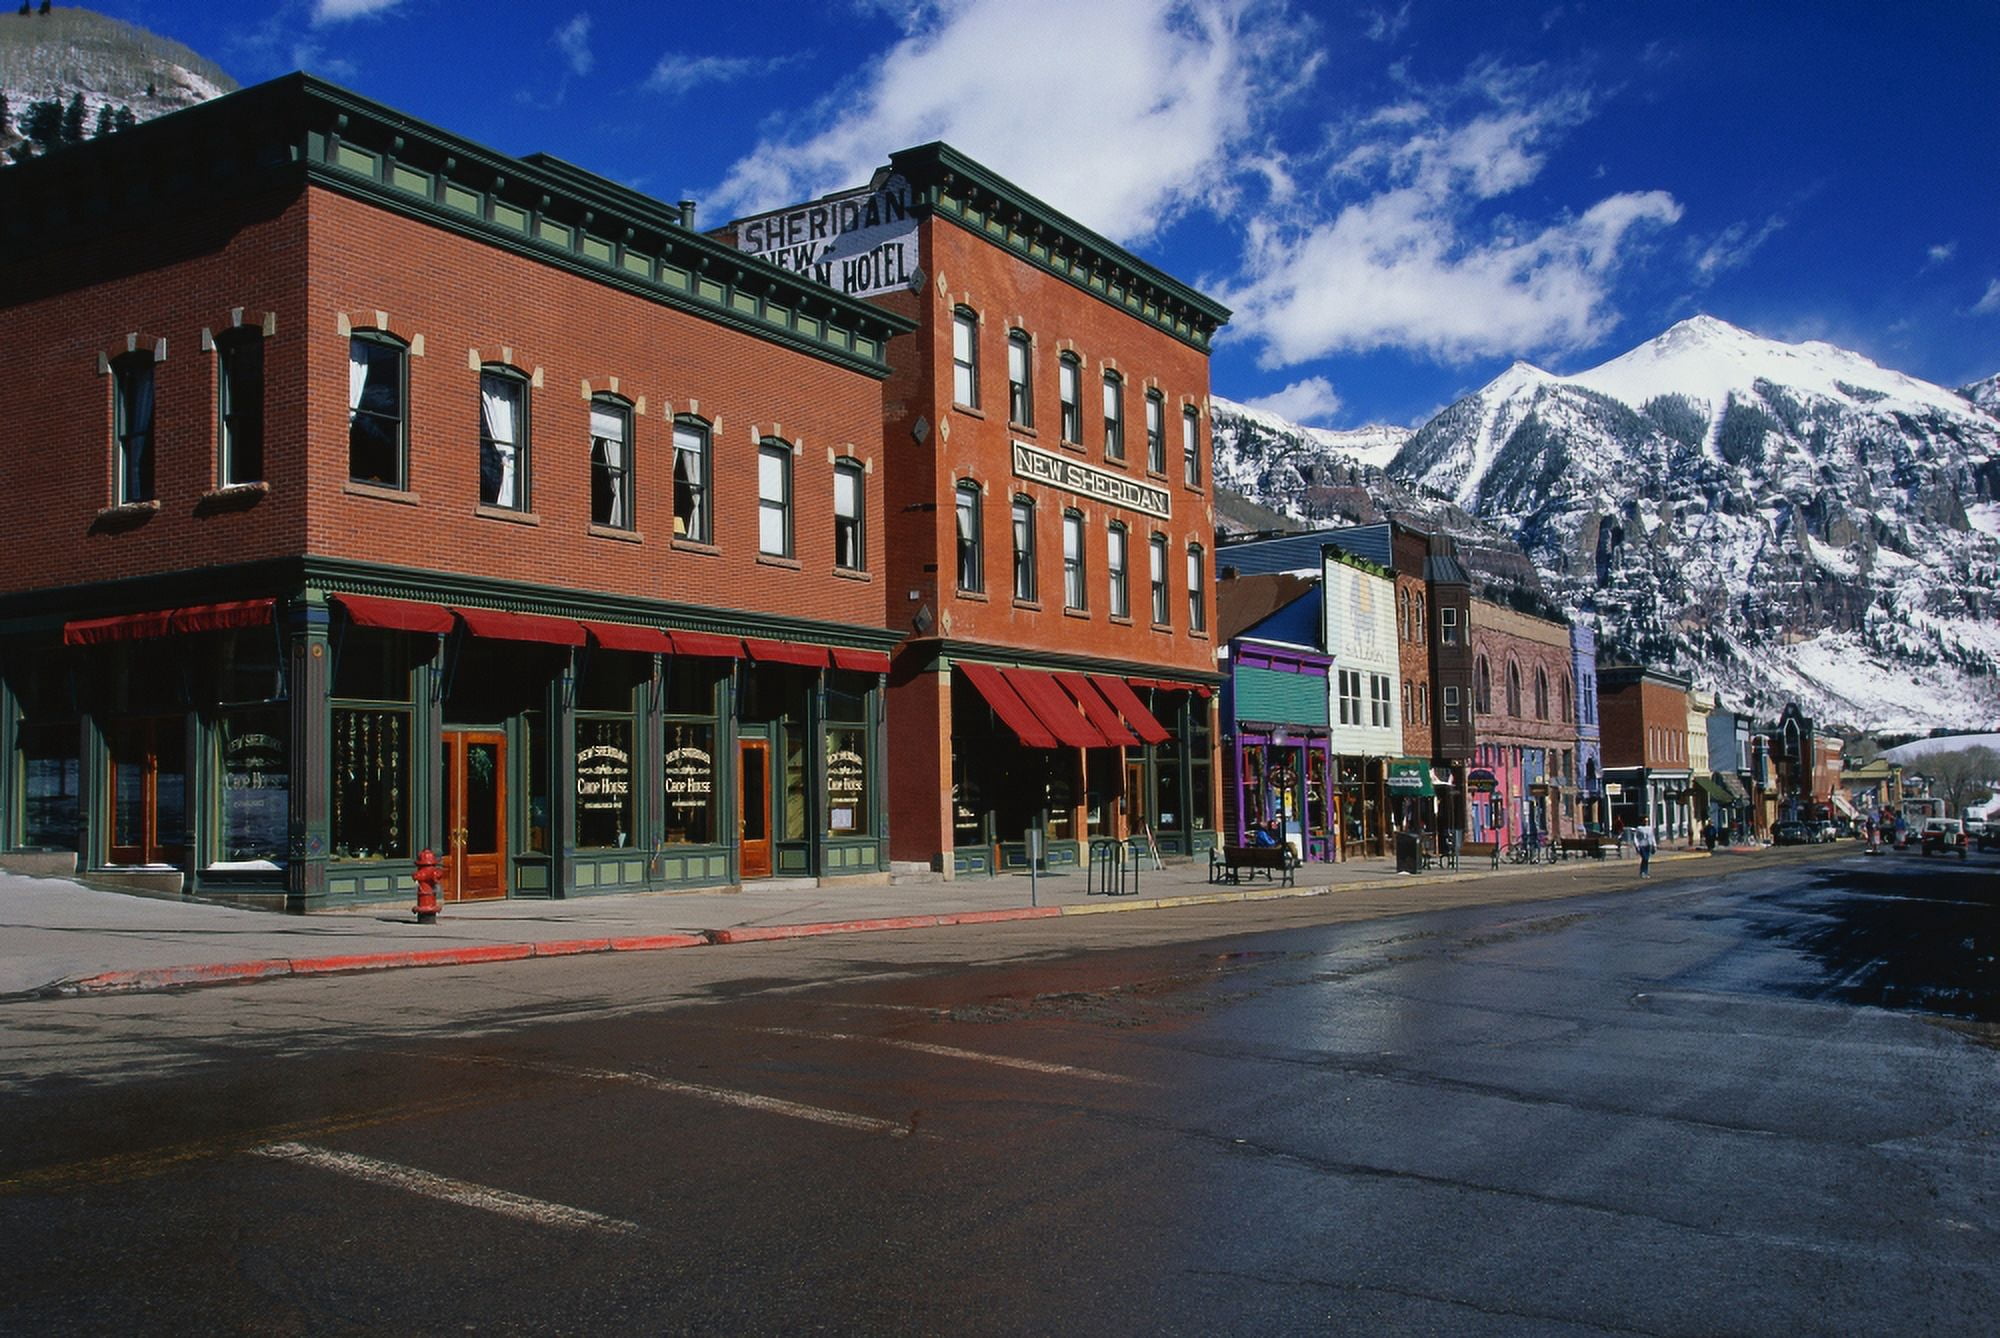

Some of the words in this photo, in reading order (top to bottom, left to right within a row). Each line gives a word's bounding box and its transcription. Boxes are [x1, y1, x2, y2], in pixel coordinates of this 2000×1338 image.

[745, 190, 906, 253] SHERIDAN
[843, 242, 911, 294] HOTEL
[1017, 447, 1062, 481] NEW
[1067, 465, 1167, 513] SHERIDAN
